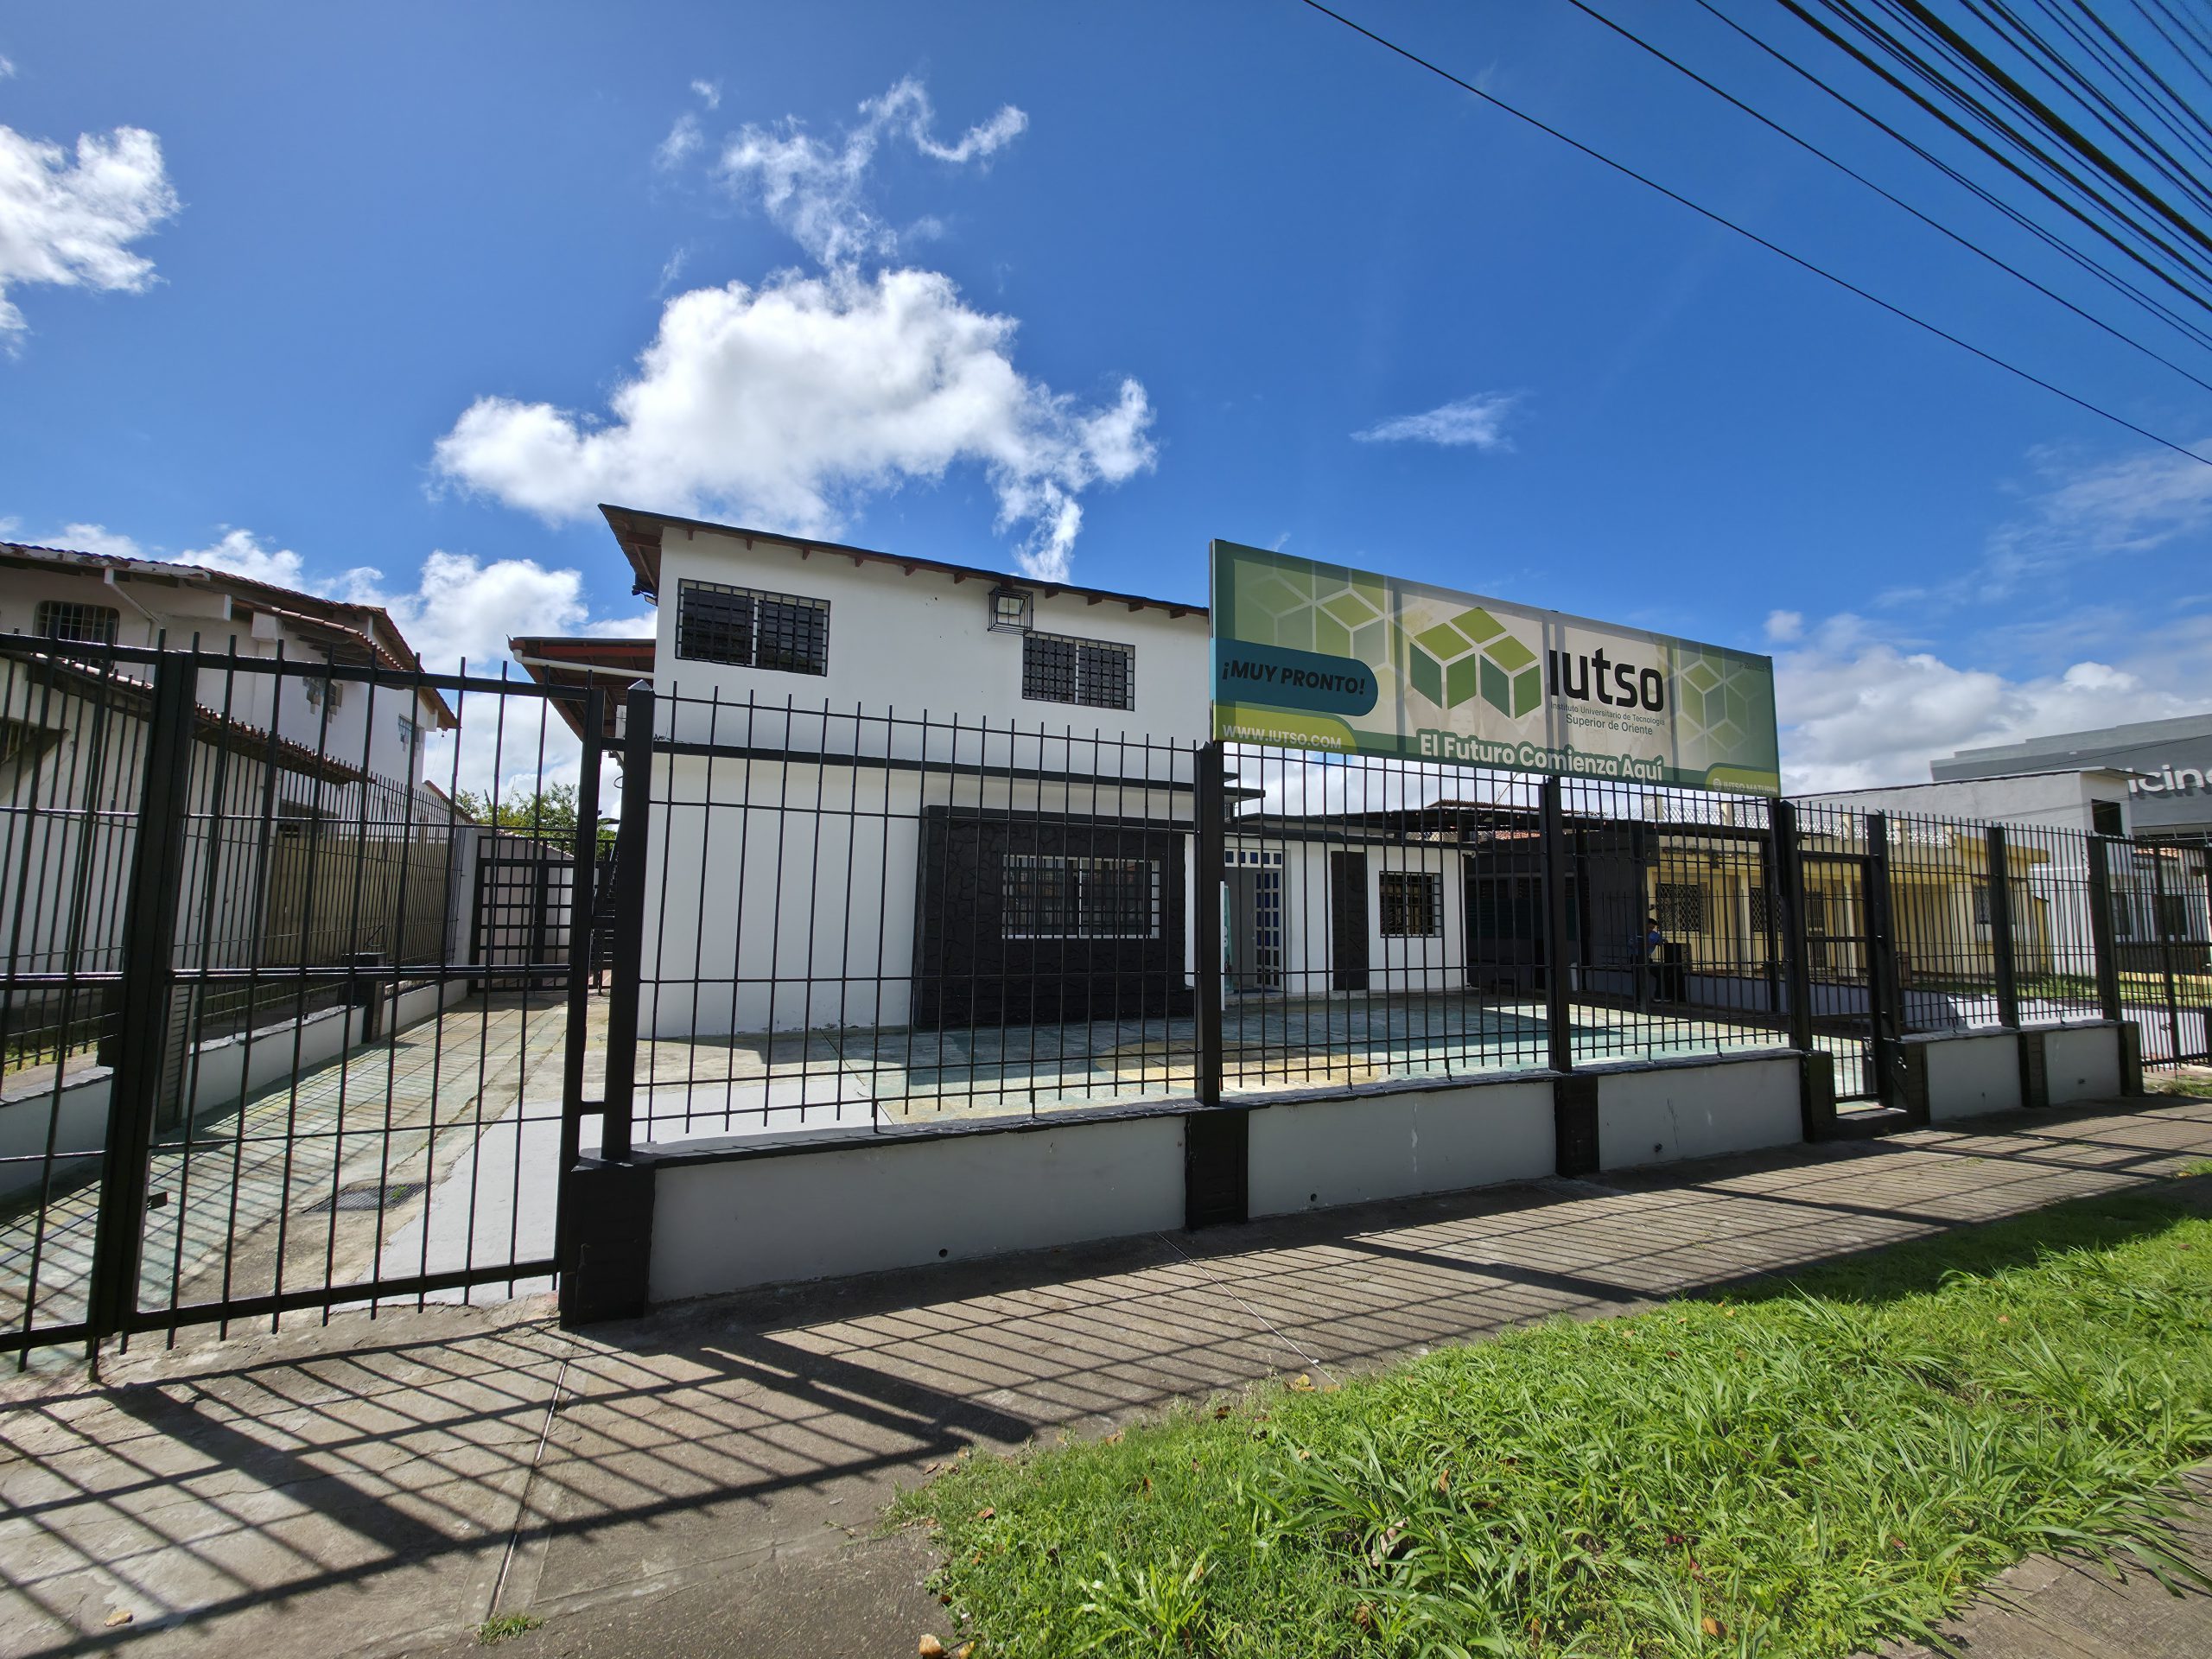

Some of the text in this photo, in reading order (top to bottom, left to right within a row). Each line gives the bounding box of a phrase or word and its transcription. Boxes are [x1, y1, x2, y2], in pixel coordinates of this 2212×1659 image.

[1223, 660, 1364, 695] ¡MUY PRONTO!
[1550, 702, 1579, 713] Instituto
[1580, 707, 1622, 719] Universitario
[1223, 724, 1341, 749] WWW.IUTSO.COM
[1566, 713, 1653, 735] Superior de Oriente
[1421, 734, 1662, 785] El Futuro Comienza Aquí
[1723, 781, 1745, 792] IUTSO
[2118, 764, 2212, 793] icin
